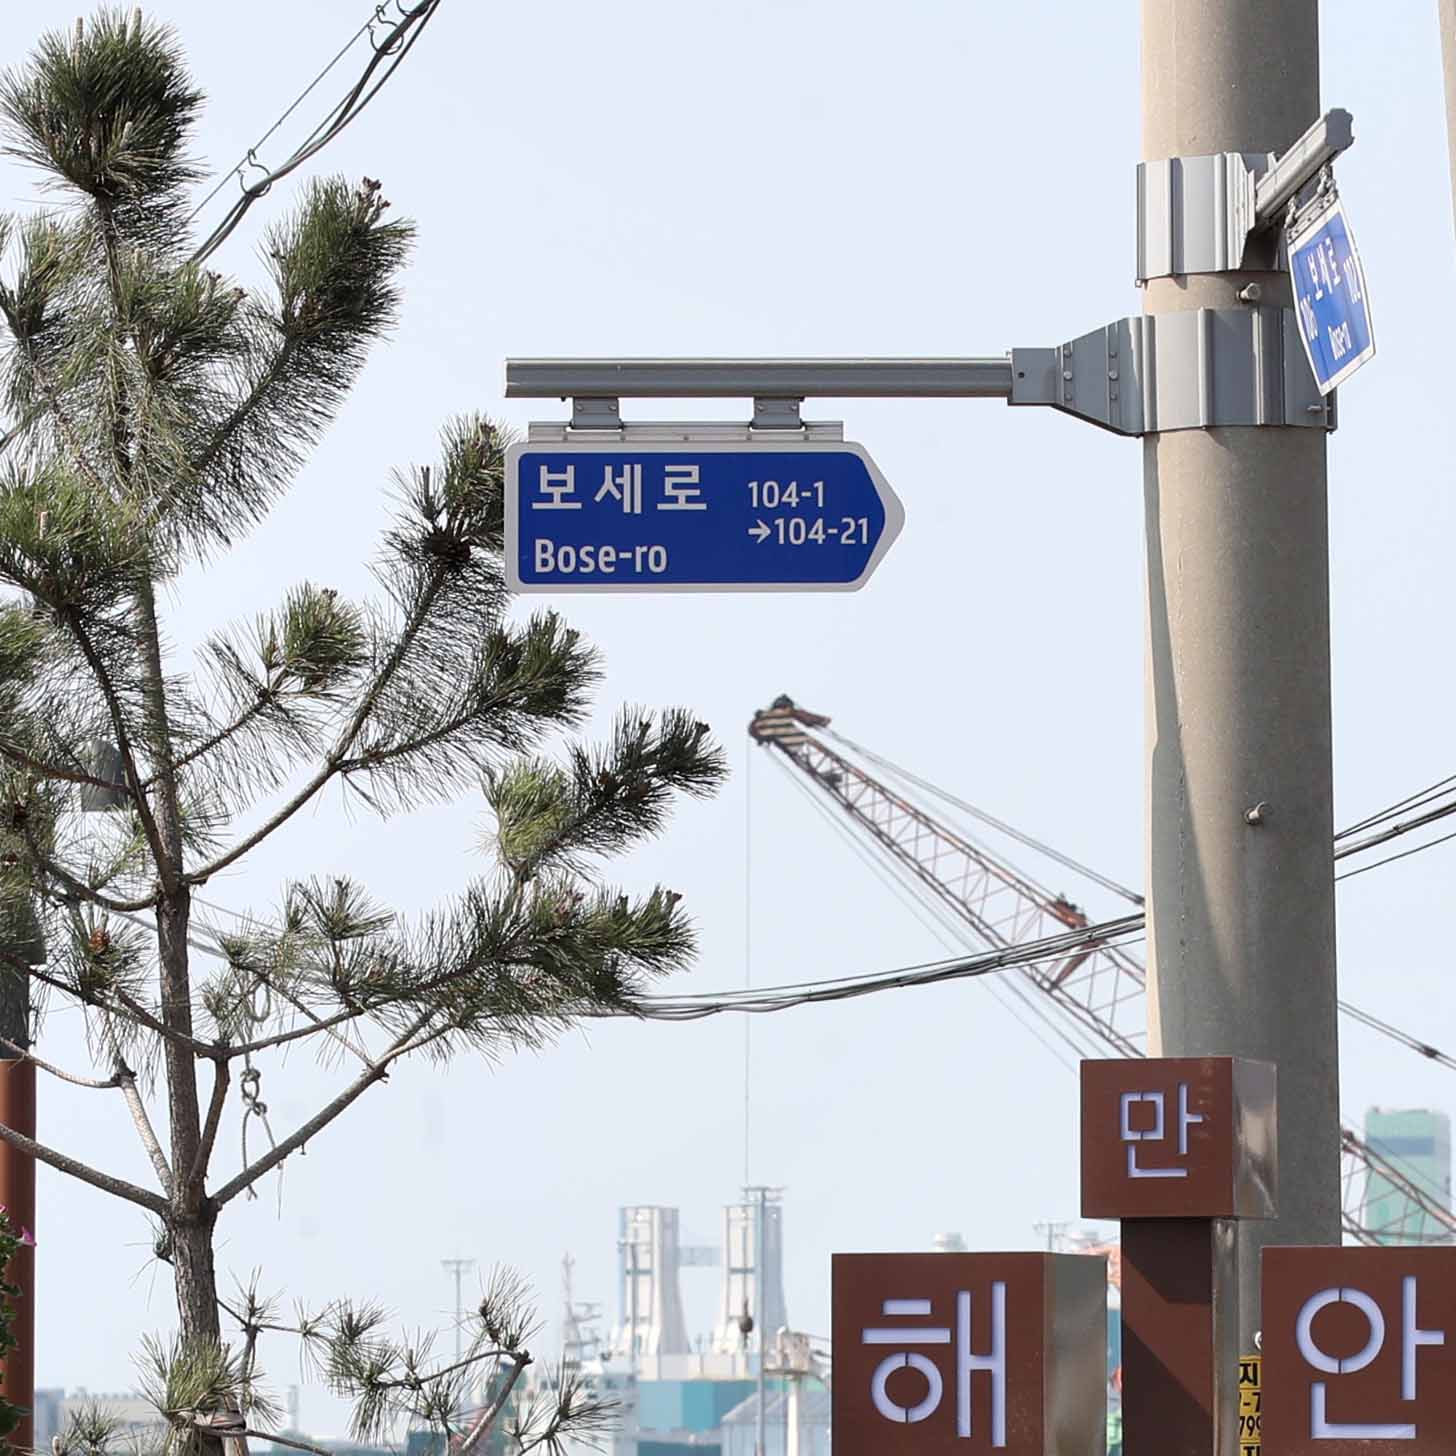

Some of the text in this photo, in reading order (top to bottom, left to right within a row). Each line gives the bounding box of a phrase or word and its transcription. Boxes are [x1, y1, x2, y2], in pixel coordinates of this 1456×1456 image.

[531, 463, 707, 514] 보세로
[748, 480, 825, 508] 104-1
[535, 538, 668, 574] Bose-ro
